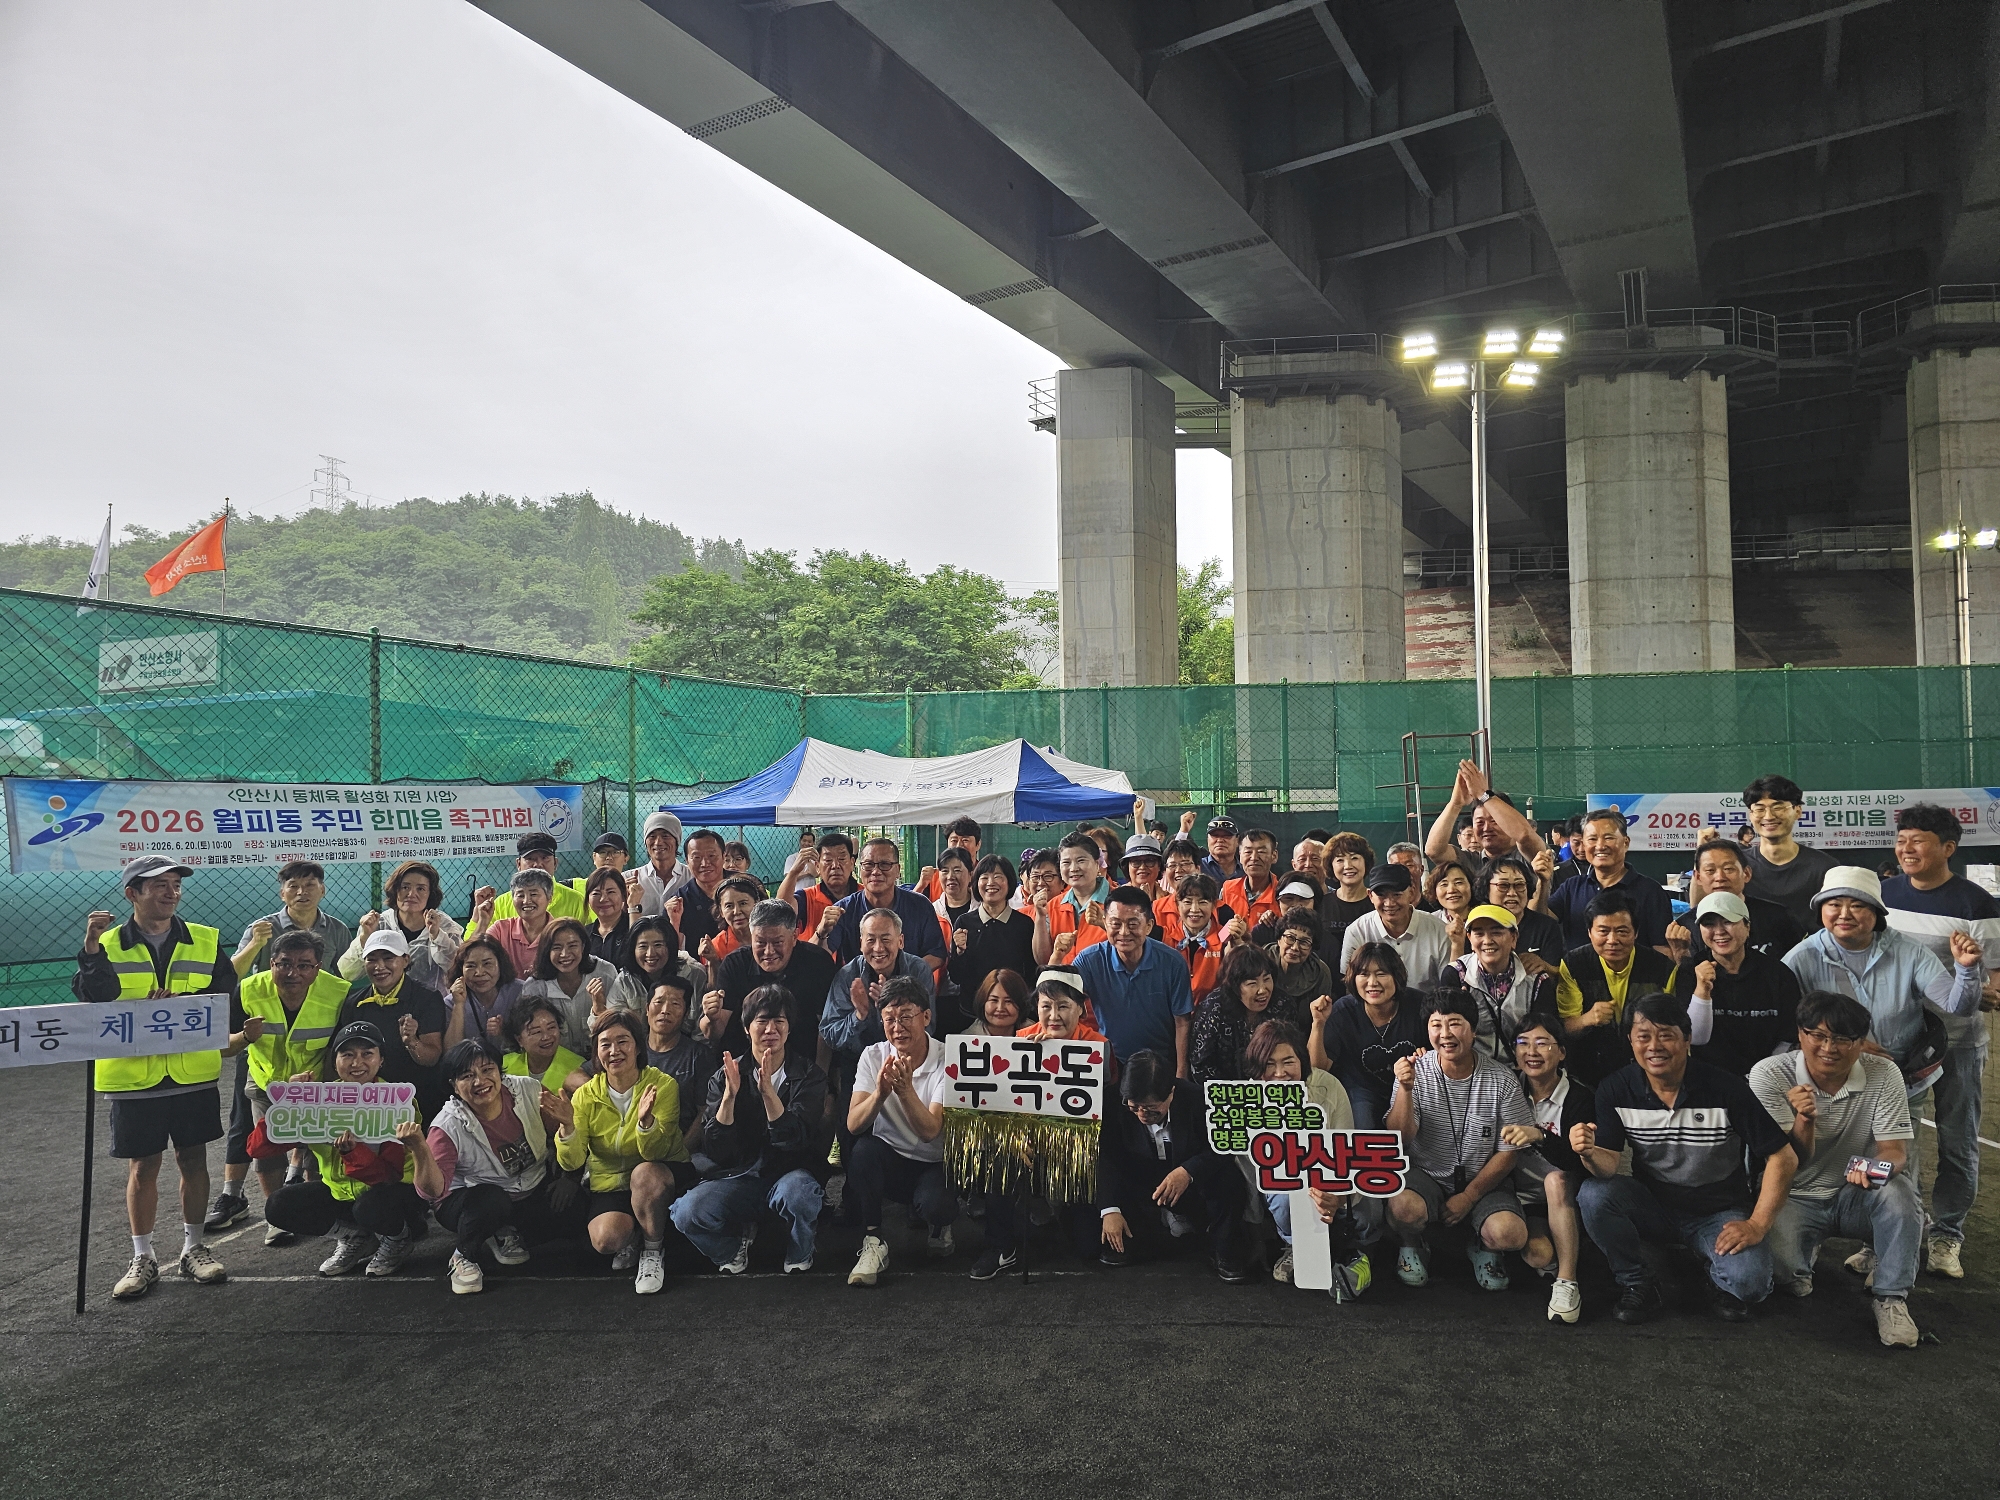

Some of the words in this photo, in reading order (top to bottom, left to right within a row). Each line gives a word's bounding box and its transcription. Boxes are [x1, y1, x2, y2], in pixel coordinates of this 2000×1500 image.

[292, 789, 341, 804] 동체육
[343, 790, 389, 804] 활성화
[393, 790, 421, 804] 지원
[1805, 795, 1843, 807] 활성화
[1846, 794, 1871, 806] 지원
[117, 809, 204, 833] 2026
[212, 808, 303, 834] 월피동
[311, 808, 363, 833] 주민
[369, 808, 442, 831] 한마음
[449, 807, 533, 829] 족구대회
[1647, 812, 1701, 829] 2026
[1707, 811, 1748, 829] 부곡
[1797, 810, 1817, 828] 민
[1822, 809, 1887, 827] 한마음
[212, 840, 232, 849] 10:00
[251, 840, 265, 849] 장소
[187, 855, 202, 865] 대상
[207, 855, 228, 865] 월피동
[230, 854, 244, 864] 주민
[344, 1024, 369, 1035] NYC
[953, 1041, 1099, 1116] 부곡동
[285, 1085, 320, 1104] 우리
[324, 1085, 359, 1104] 지금
[362, 1086, 396, 1104] 여기
[1210, 1085, 1262, 1105] 천년의
[1266, 1086, 1302, 1105] 역사
[270, 1108, 409, 1138] 안산동에서
[1211, 1108, 1282, 1128] 수암봉을
[1286, 1108, 1322, 1128] 품은
[1213, 1131, 1248, 1150] 명품
[1251, 1132, 1406, 1193] 안산동
